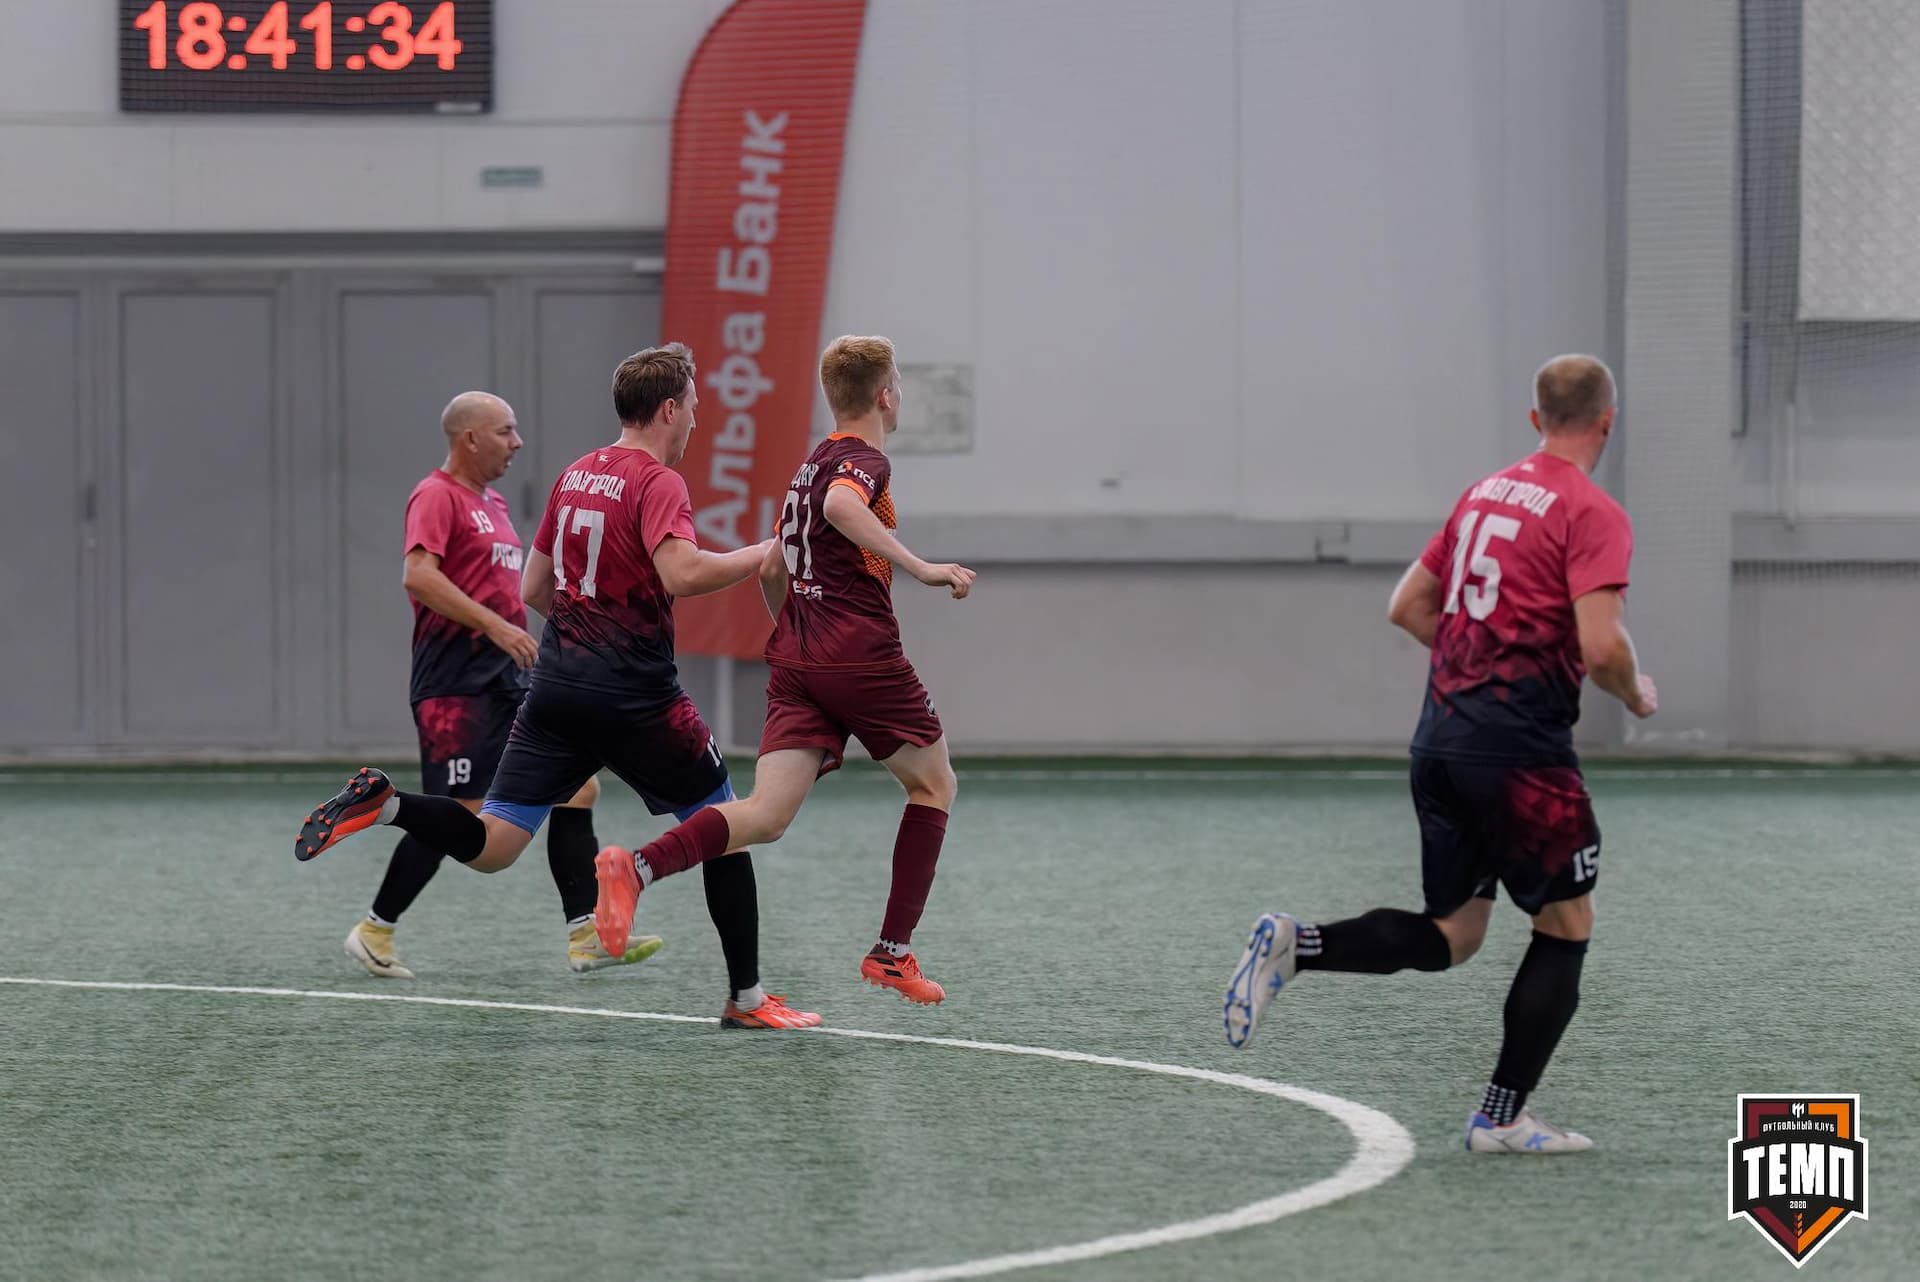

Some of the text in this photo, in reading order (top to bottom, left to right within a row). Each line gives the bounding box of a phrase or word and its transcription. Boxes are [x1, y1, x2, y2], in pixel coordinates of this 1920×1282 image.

[134, 0, 462, 70] 18:41:34
[695, 110, 789, 550] Альфа Банк
[471, 510, 495, 534] 19
[553, 505, 605, 599] 17
[781, 490, 813, 580] 21
[1444, 510, 1522, 621] 15
[448, 758, 471, 785] 19
[1573, 845, 1599, 882] 15
